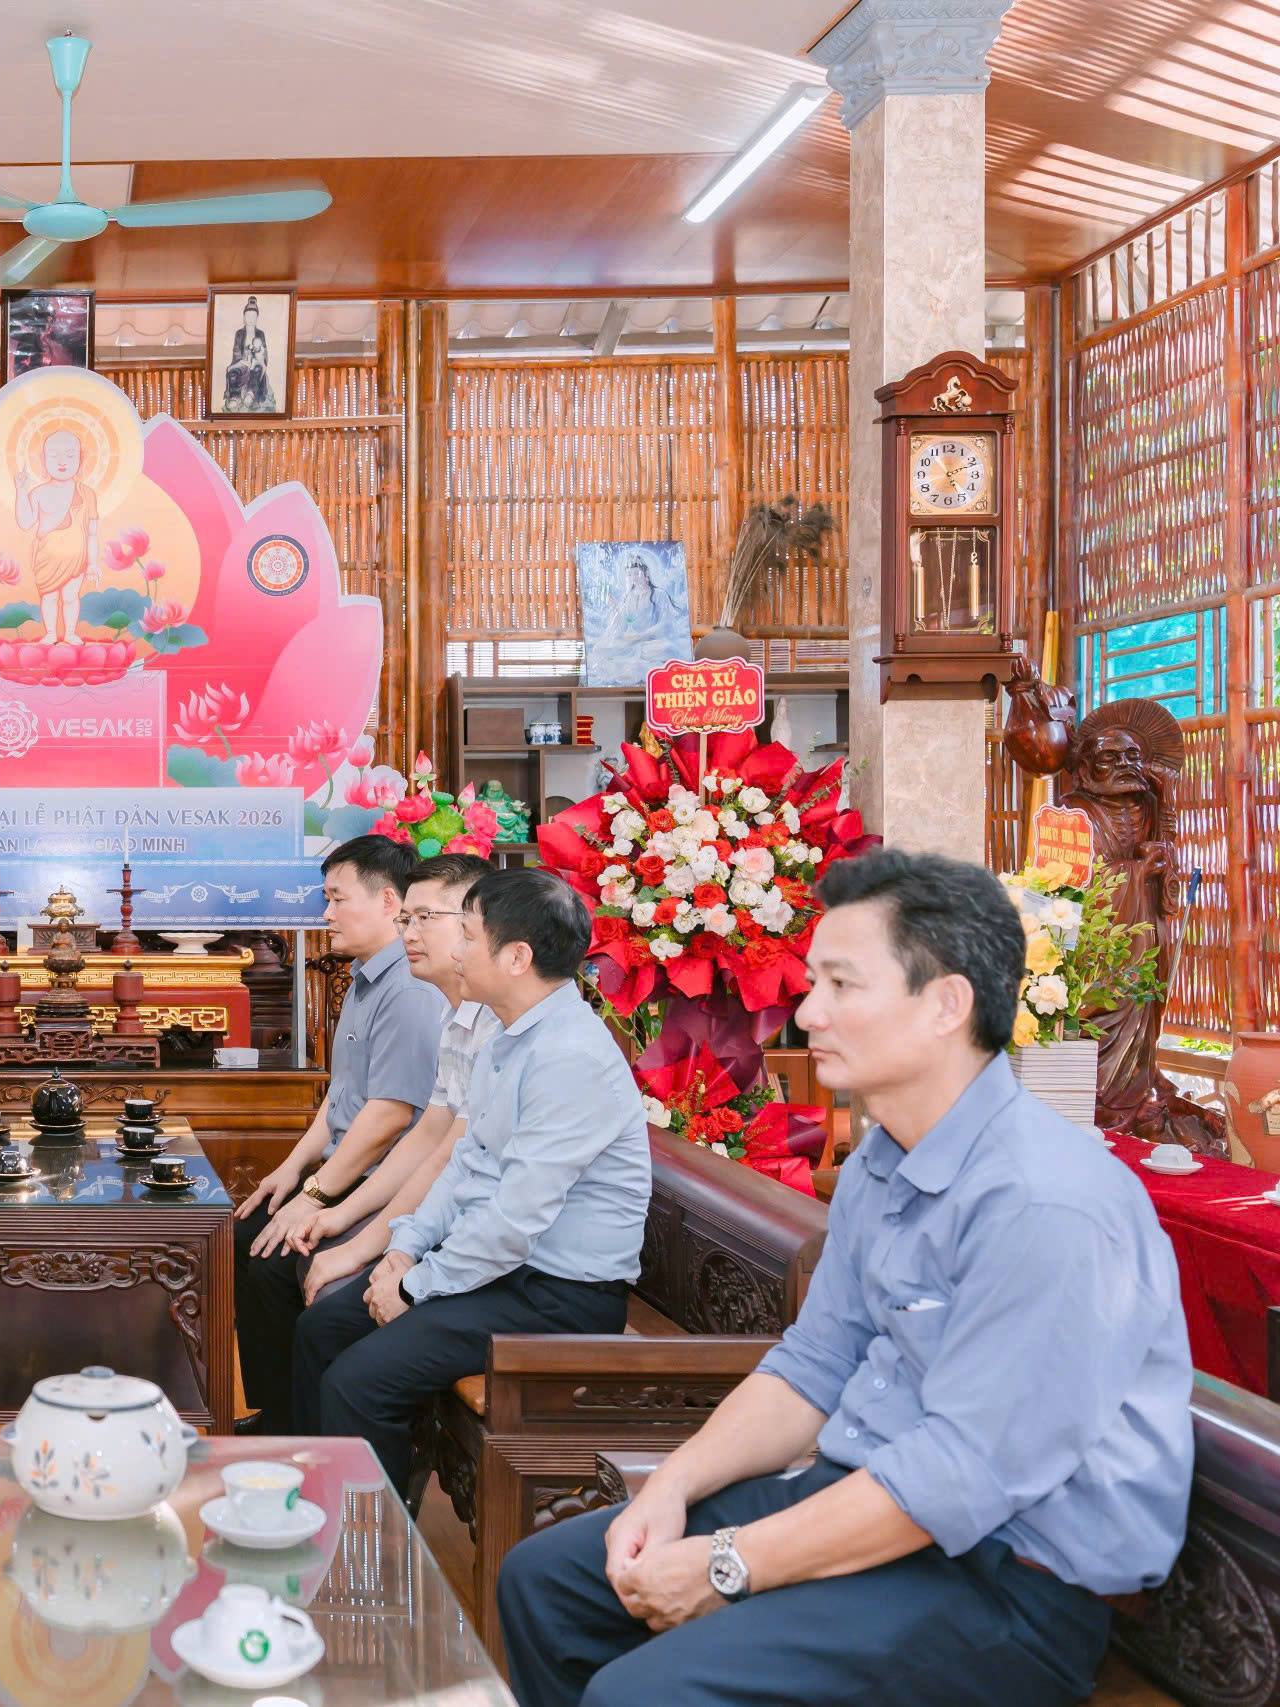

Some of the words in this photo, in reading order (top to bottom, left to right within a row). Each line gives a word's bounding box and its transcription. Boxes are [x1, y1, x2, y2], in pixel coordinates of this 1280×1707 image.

[930, 448, 939, 457] 11
[942, 443, 956, 454] 12
[920, 457, 931, 467] 10
[967, 456, 977, 466] 2
[917, 470, 926, 479] 9
[971, 470, 980, 480] 3
[920, 483, 930, 493] 8
[967, 482, 976, 491] 4
[930, 493, 940, 503] 7
[943, 496, 953, 506] 6
[957, 493, 967, 502] 5
[670, 673, 708, 689] CHA
[653, 687, 708, 711] THIỆN
[711, 685, 758, 707] GIÁO
[46, 718, 136, 738] VESAK
[24, 802, 46, 827] LỄ
[53, 805, 107, 829] PHẬT
[114, 803, 160, 827] ĐẢN
[166, 809, 231, 827] VESAK
[238, 809, 284, 827] 2026
[142, 837, 186, 852] MINH
